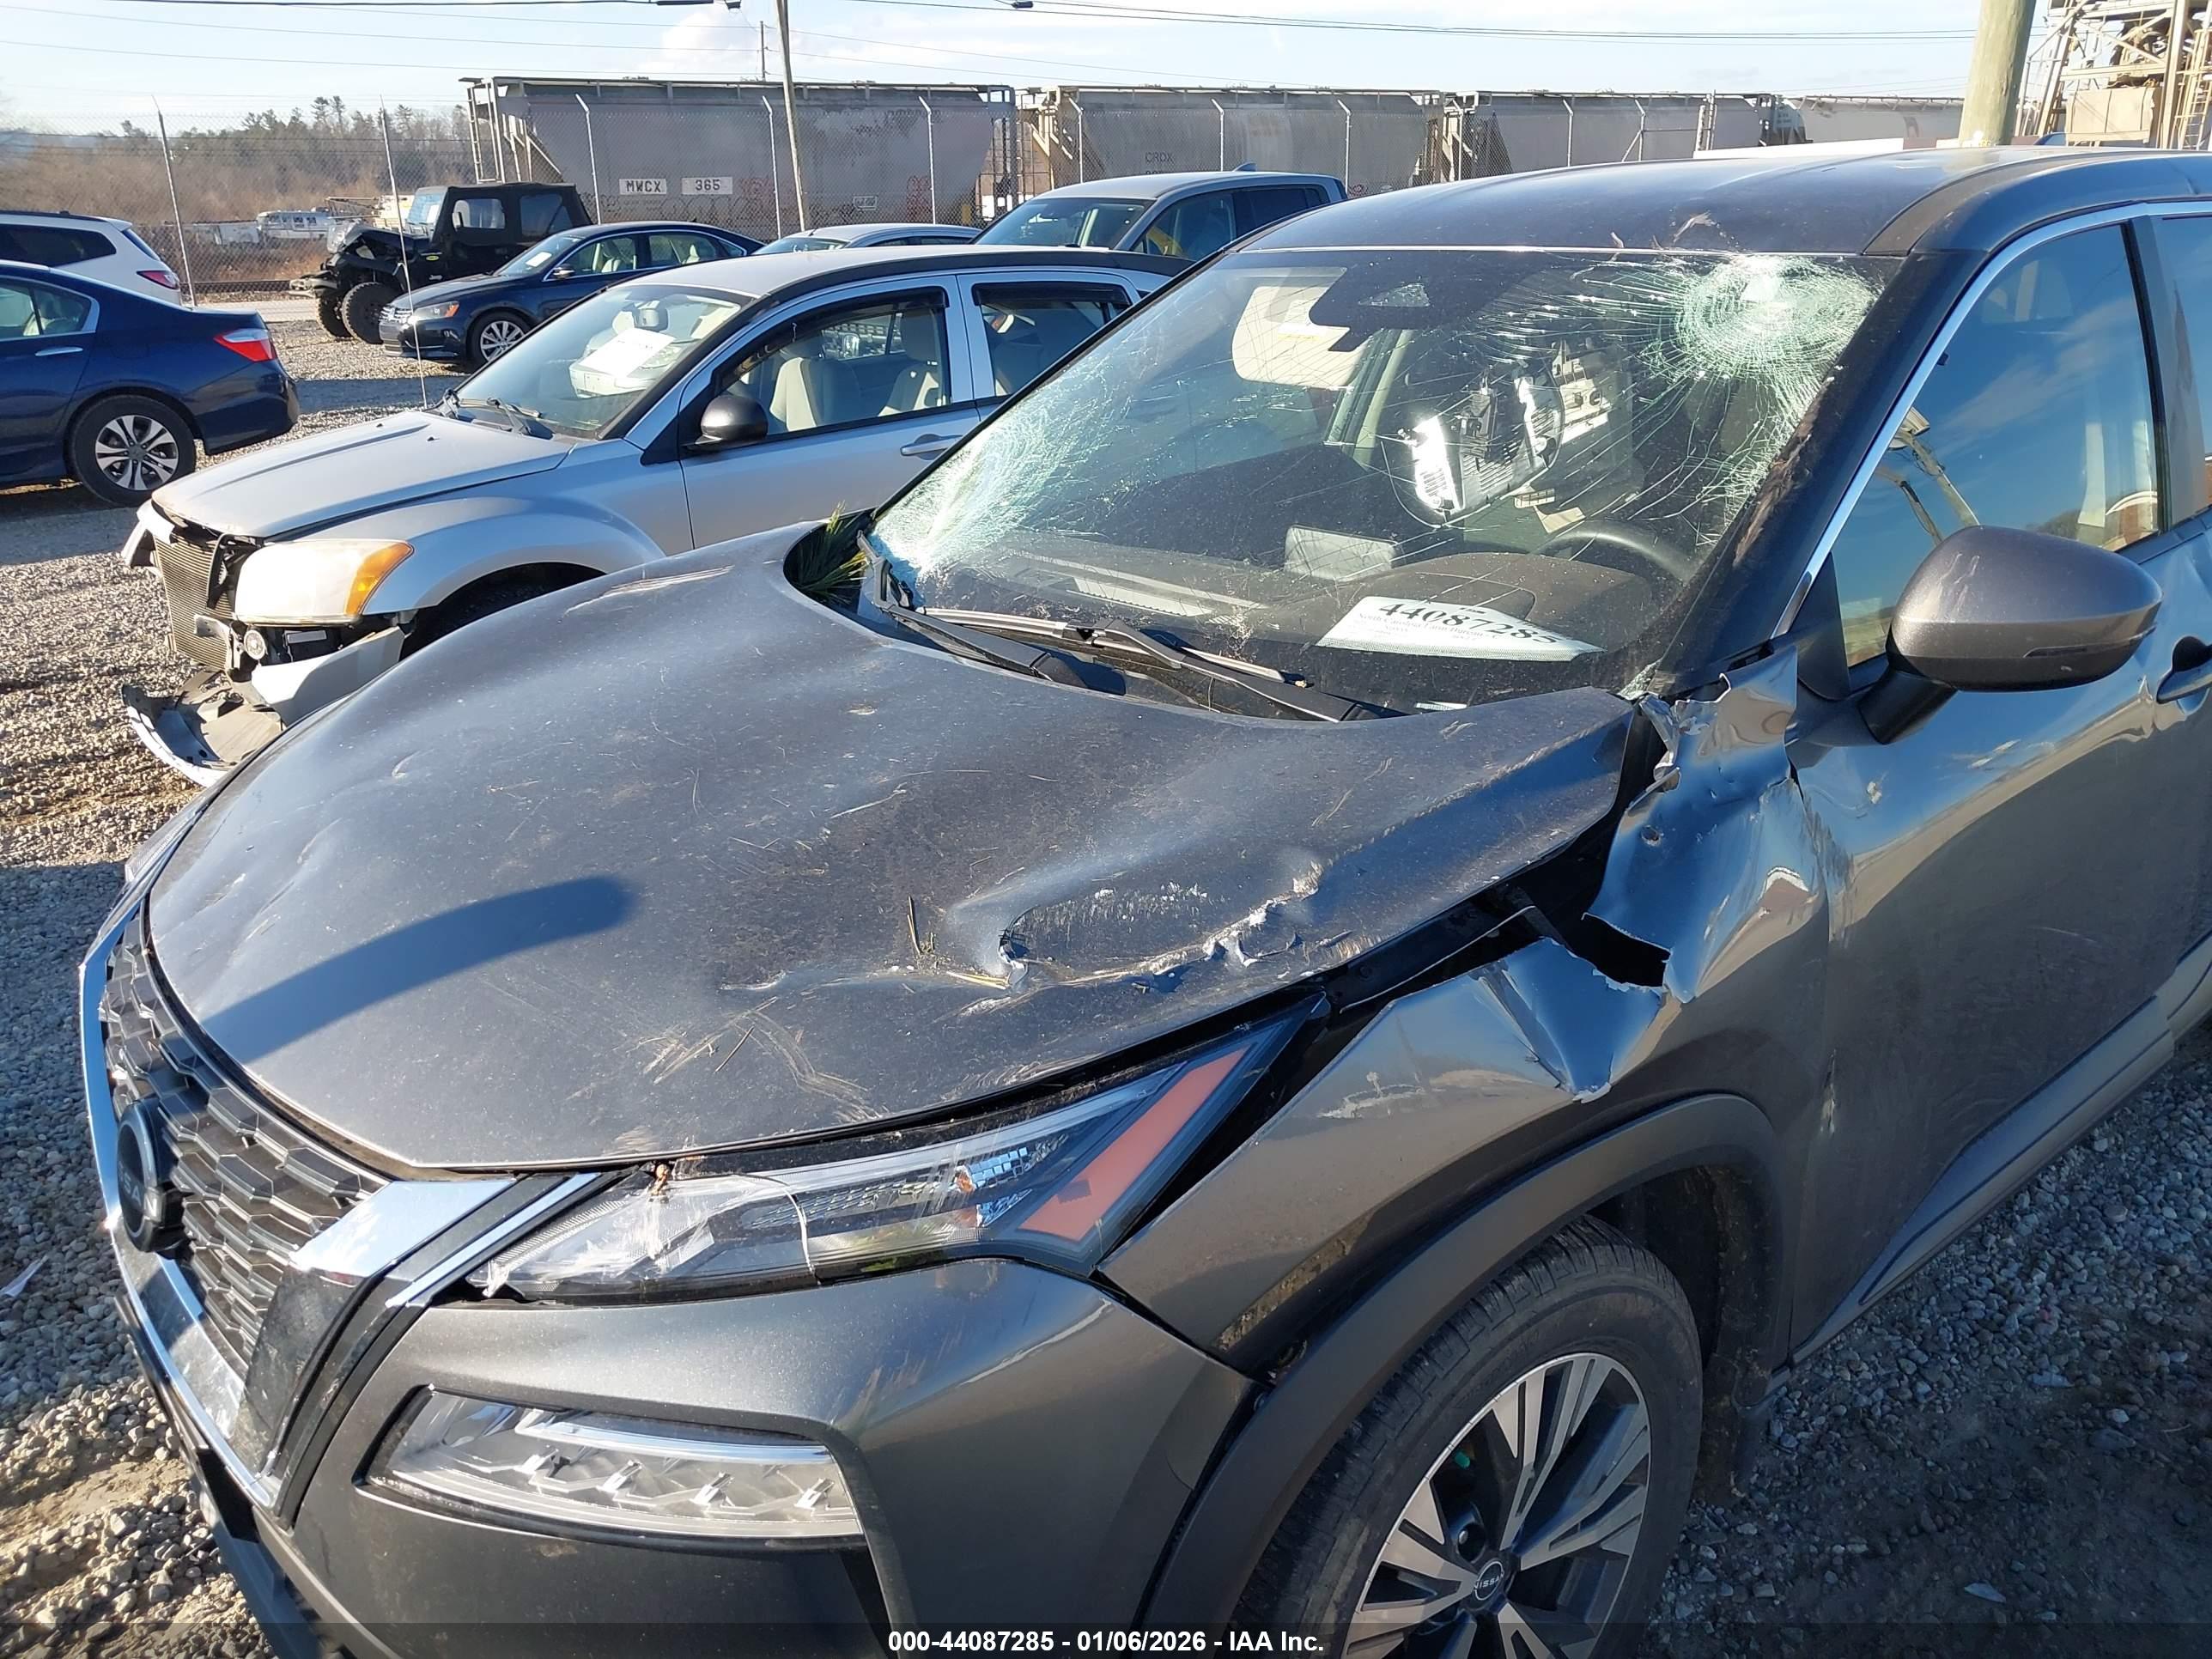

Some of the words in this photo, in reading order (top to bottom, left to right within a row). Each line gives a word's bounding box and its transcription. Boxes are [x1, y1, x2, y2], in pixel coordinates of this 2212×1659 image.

[627, 179, 661, 192] MWCX
[696, 179, 720, 191] 365
[1378, 604, 1561, 643] 44087285
